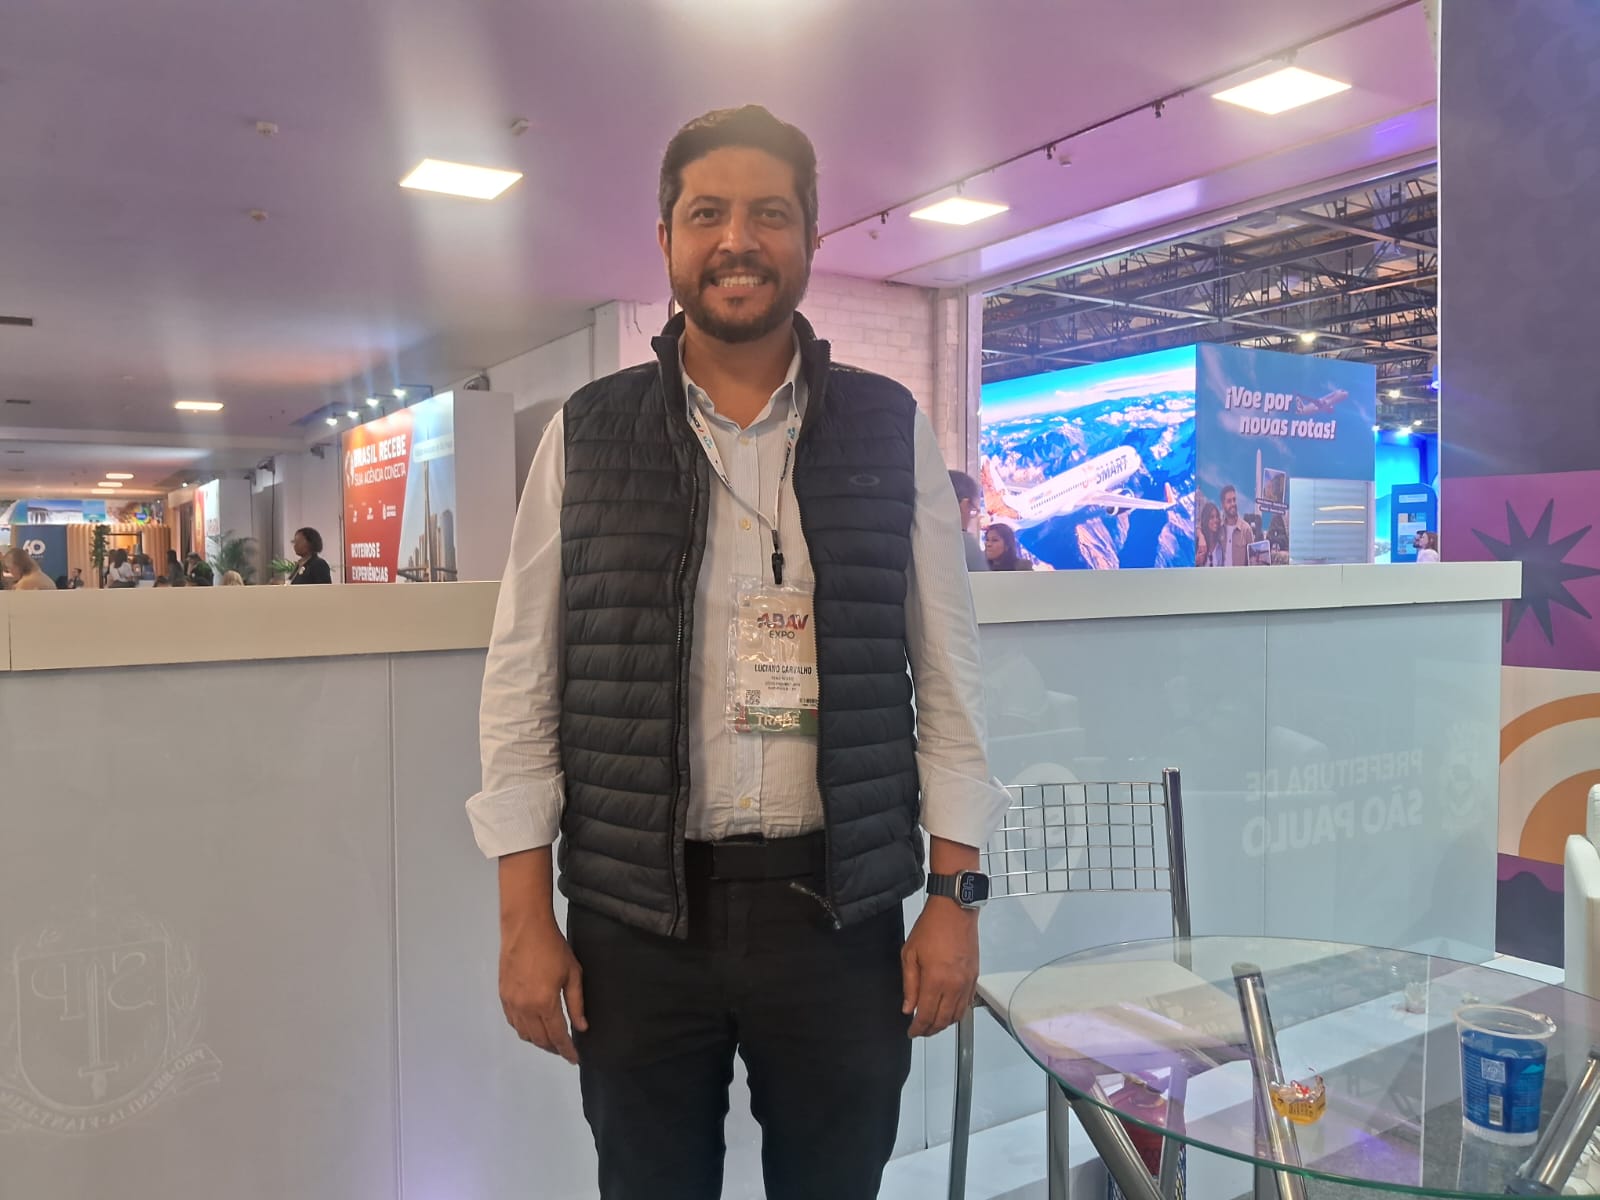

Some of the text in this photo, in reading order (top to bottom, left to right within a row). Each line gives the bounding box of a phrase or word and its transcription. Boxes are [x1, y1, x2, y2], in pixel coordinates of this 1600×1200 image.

[1225, 386, 1293, 413] ¡Voe por
[1240, 416, 1337, 440] novas rotas!
[352, 444, 377, 468] BRASIL
[378, 435, 406, 462] RECEBE
[384, 462, 406, 480] CONECTA
[351, 542, 381, 558] ROTEIROS E
[351, 562, 389, 583] EXPERIÊNCIAS
[757, 613, 809, 630] ABAV
[769, 630, 796, 640] EXPO
[754, 663, 813, 676] LUCIANO CARVALHO
